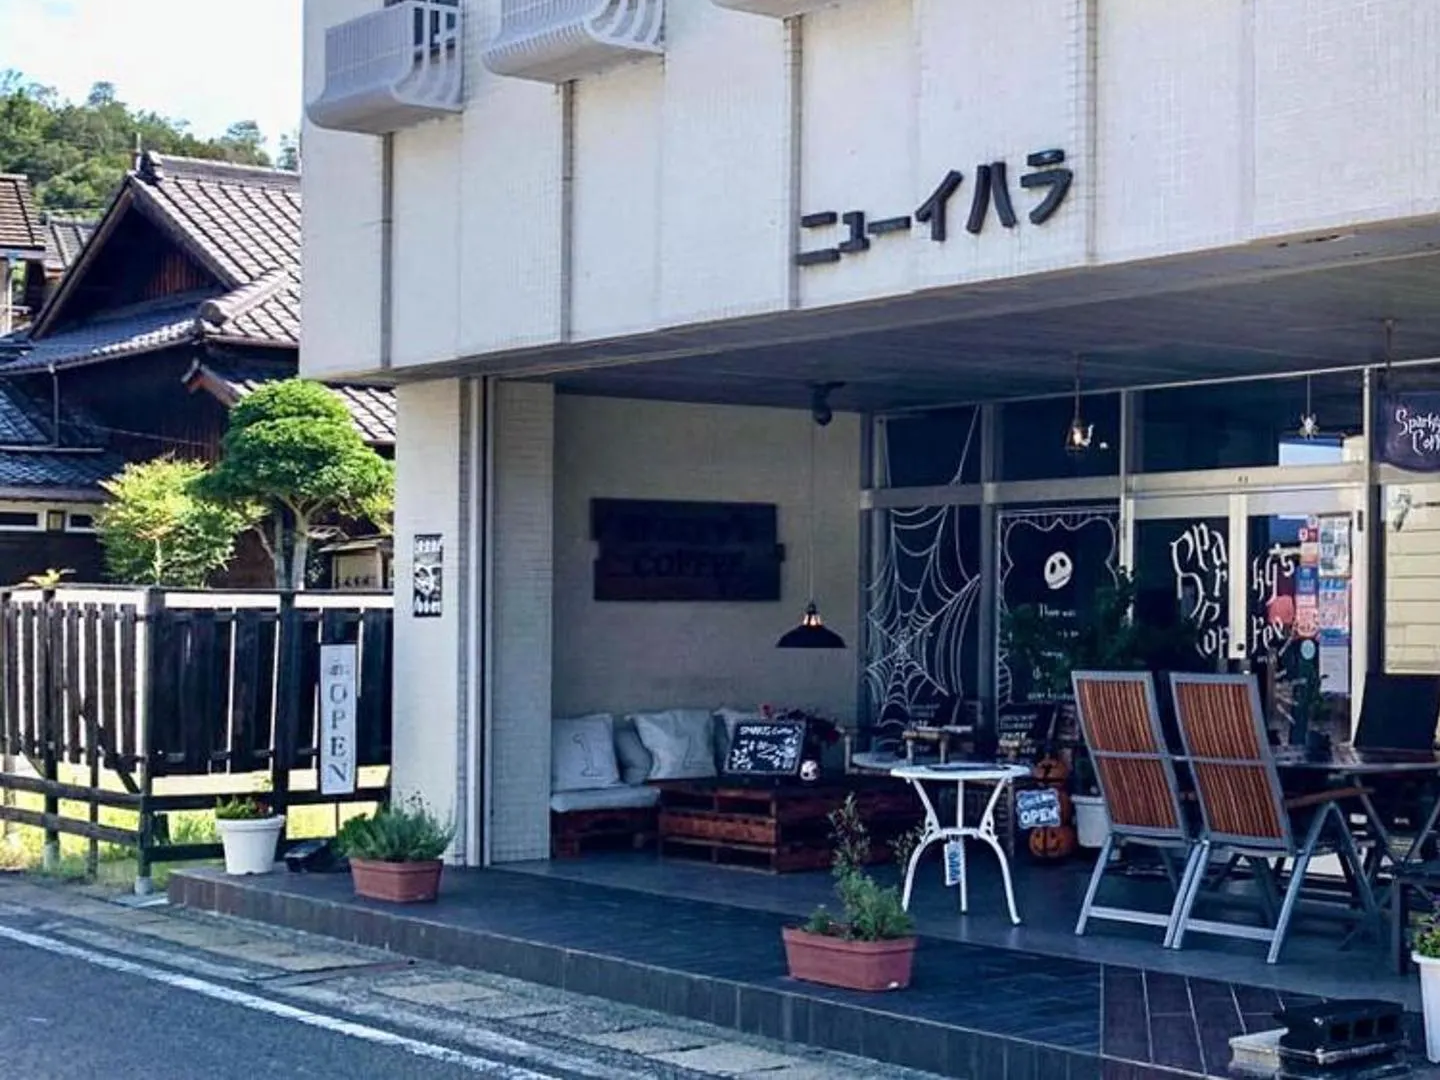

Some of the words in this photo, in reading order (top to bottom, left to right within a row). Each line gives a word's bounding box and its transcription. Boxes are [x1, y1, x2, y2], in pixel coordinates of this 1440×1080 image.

[796, 148, 1074, 266] ニューイハラ
[328, 683, 348, 783] OPEN
